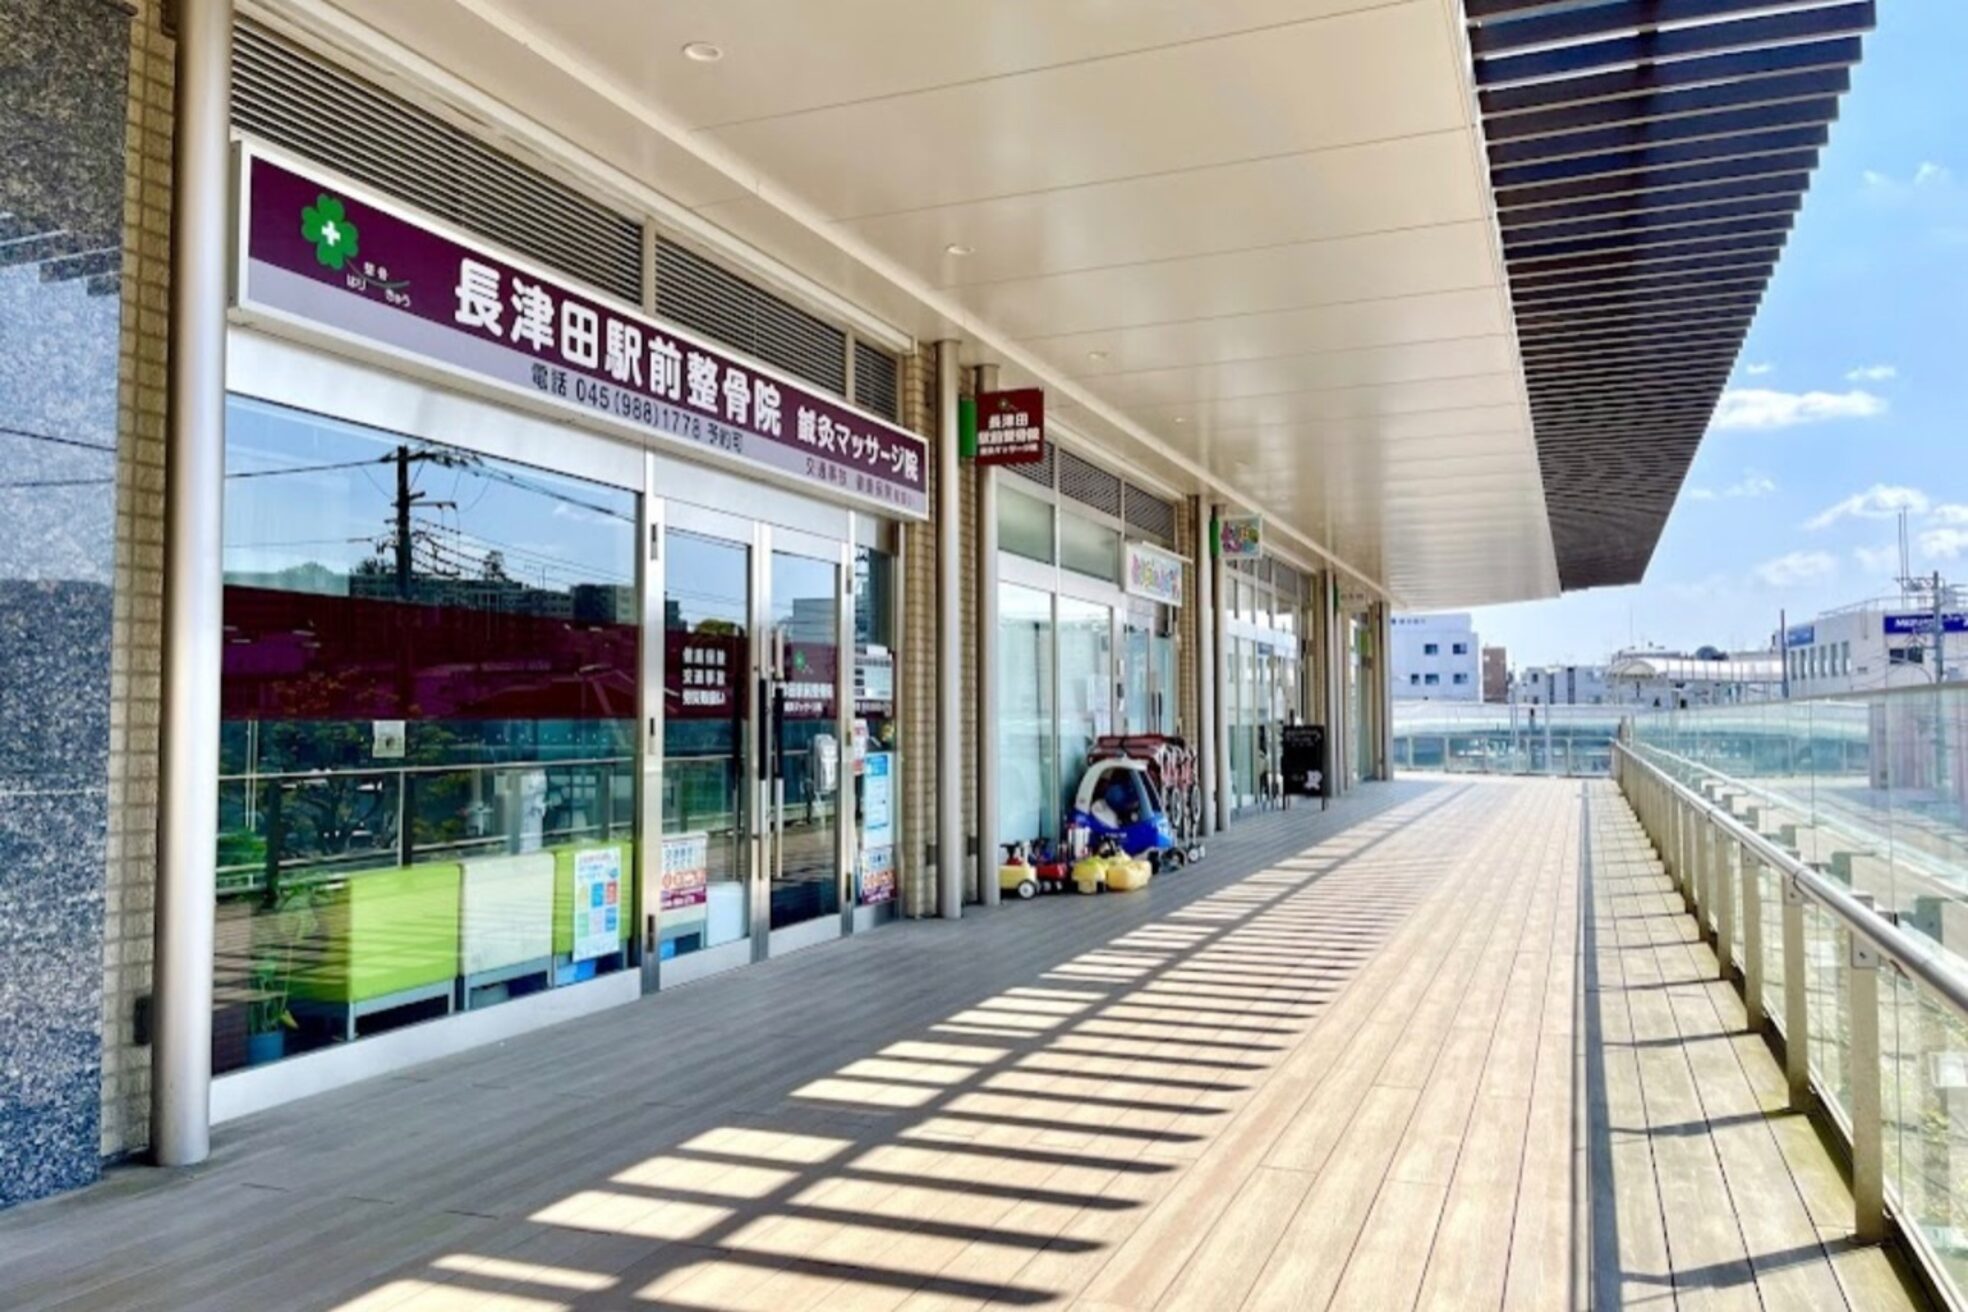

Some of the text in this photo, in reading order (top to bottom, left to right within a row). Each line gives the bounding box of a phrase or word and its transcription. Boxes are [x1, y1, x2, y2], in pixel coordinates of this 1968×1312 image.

[347, 272, 366, 291] はり
[385, 289, 411, 308] きゅう
[454, 257, 919, 482] 長津田駅前整骨院 鍼灸マッサージ院
[531, 362, 568, 398] 電話
[575, 375, 701, 440] 045(988)1778
